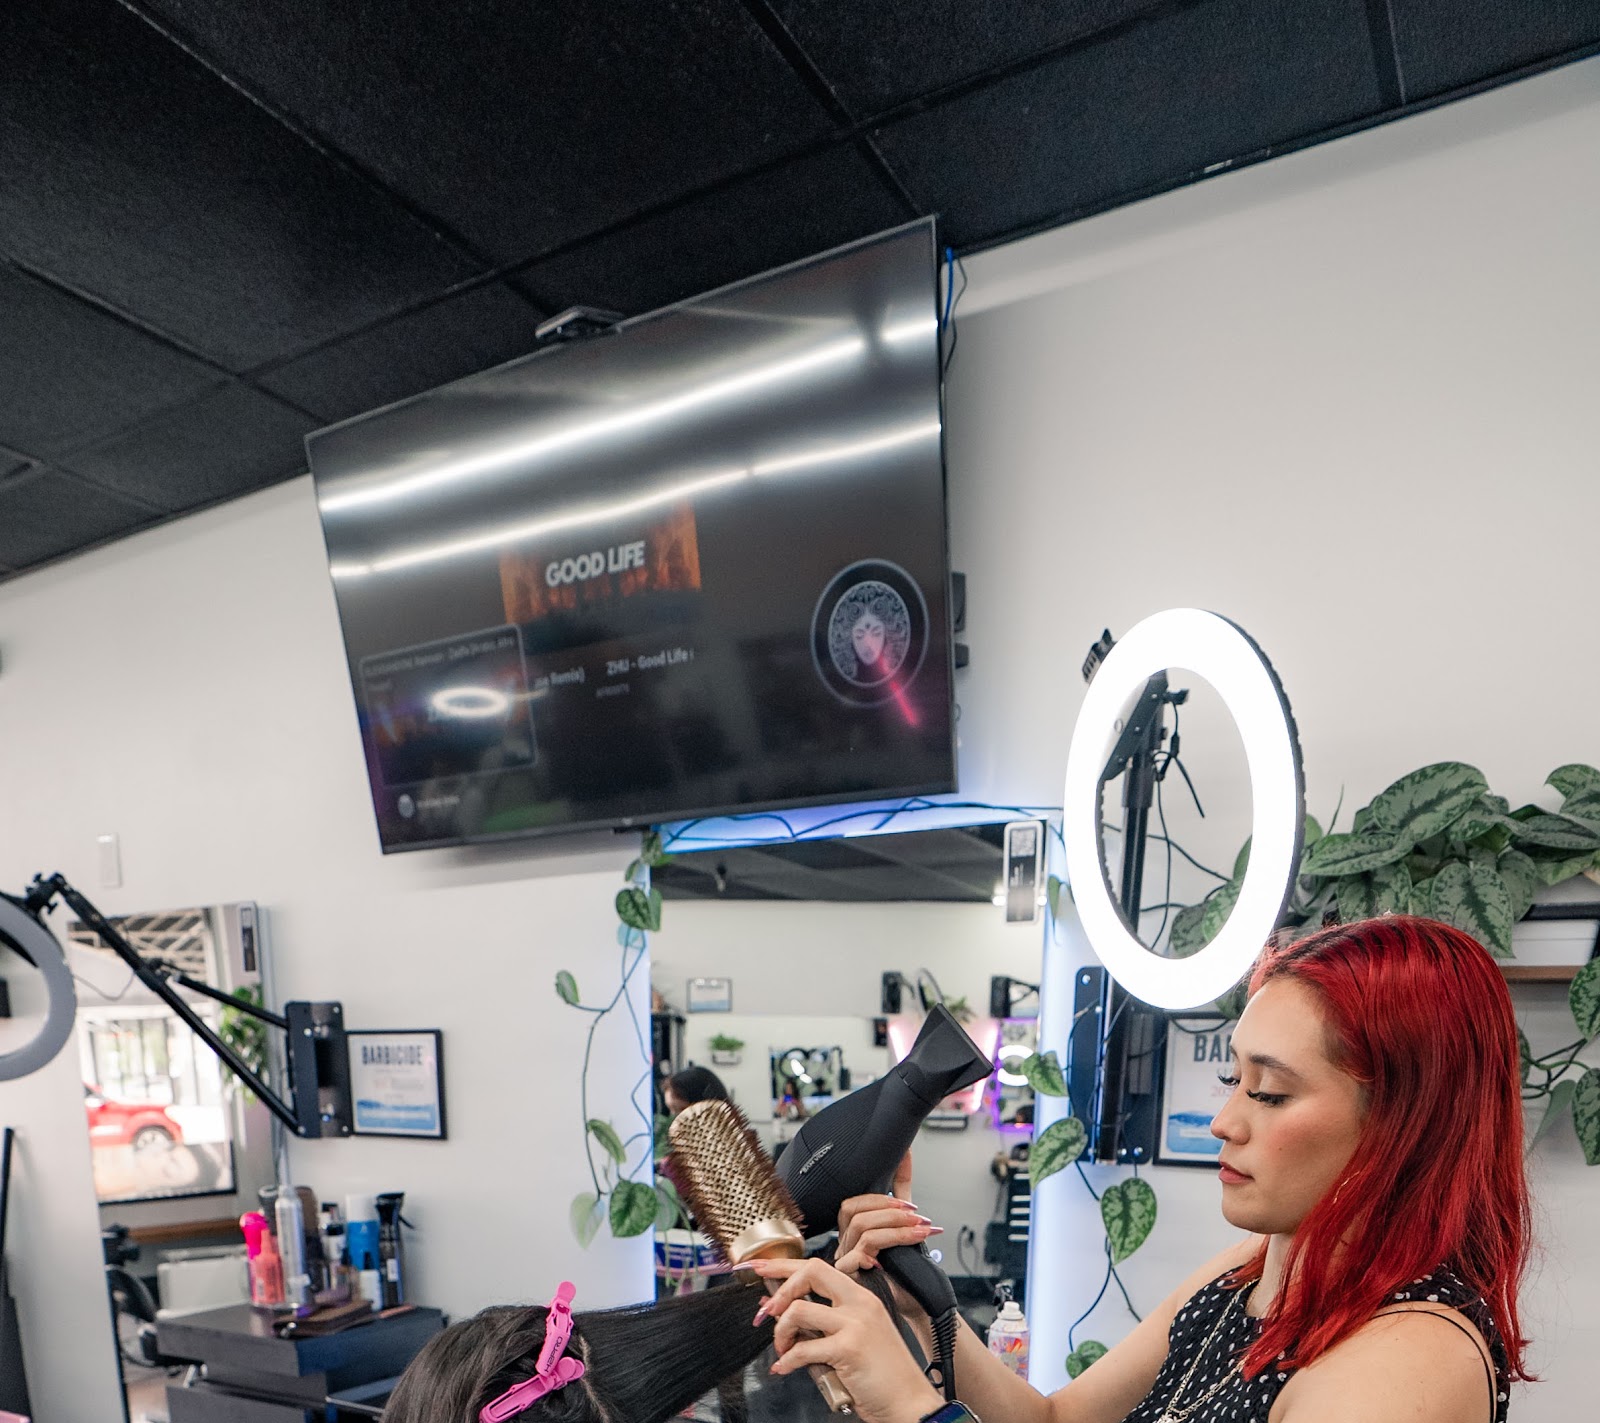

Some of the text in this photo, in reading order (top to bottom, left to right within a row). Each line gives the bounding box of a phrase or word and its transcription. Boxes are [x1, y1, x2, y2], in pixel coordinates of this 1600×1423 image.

[545, 540, 647, 588] GOOD LIFE
[637, 650, 666, 670] Good
[666, 647, 688, 664] Life
[362, 1045, 421, 1066] BARBICIDE
